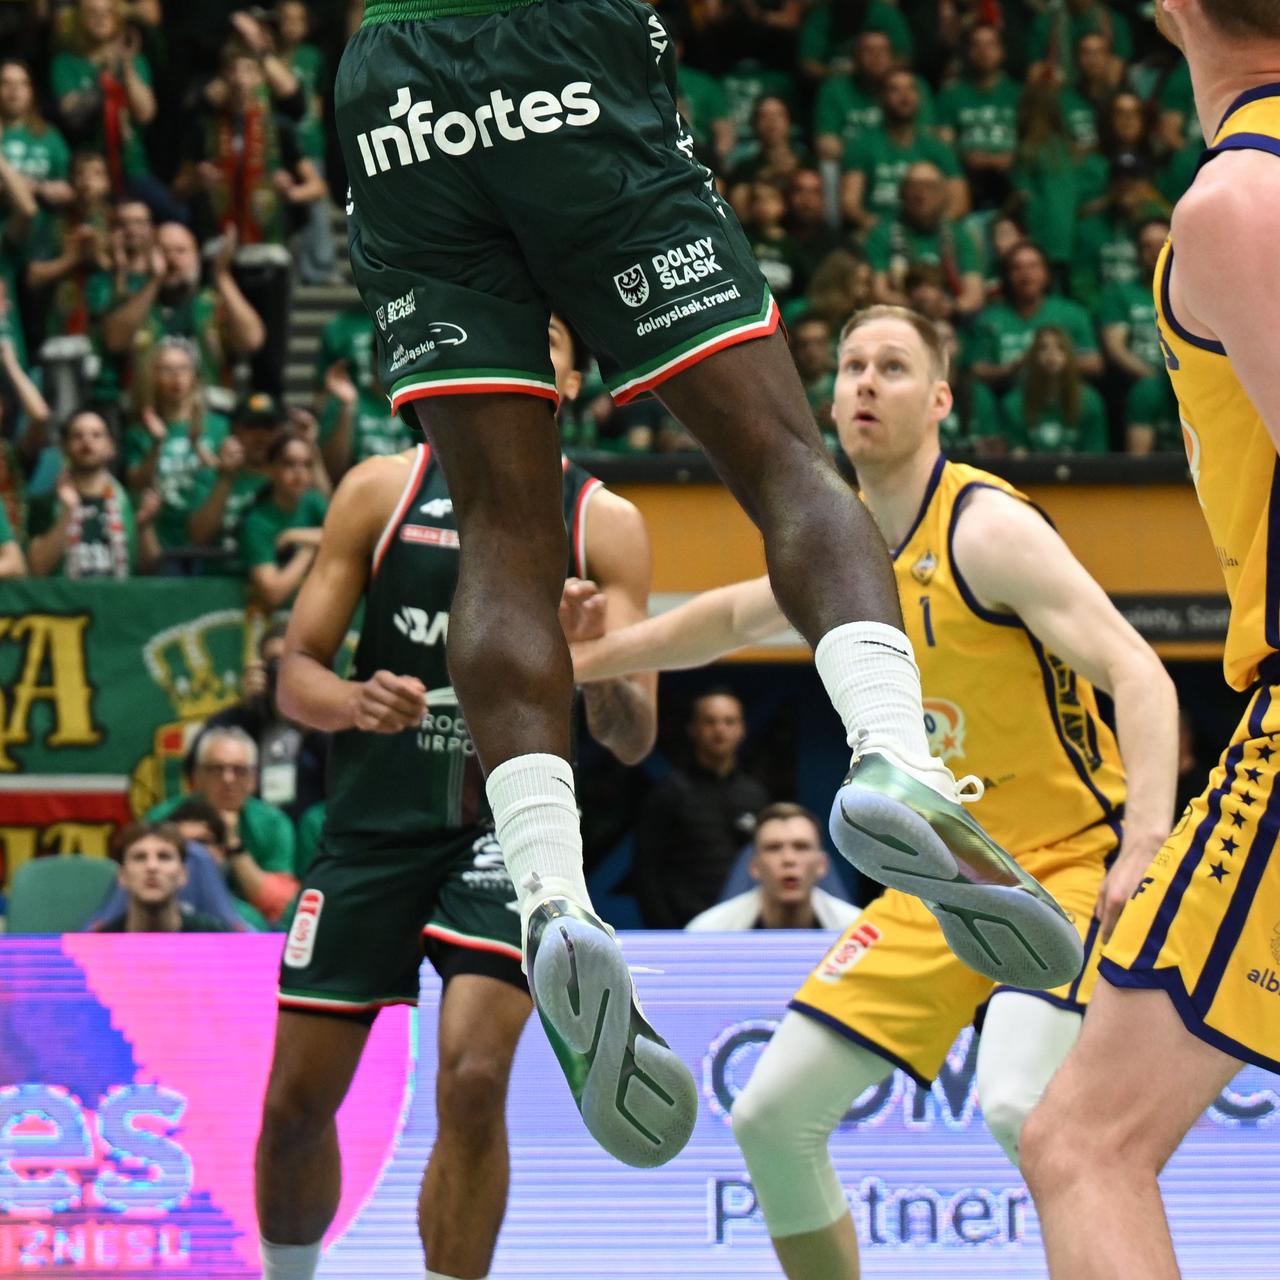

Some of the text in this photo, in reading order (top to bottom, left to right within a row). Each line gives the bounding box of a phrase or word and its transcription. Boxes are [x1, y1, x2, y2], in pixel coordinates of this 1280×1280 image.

[357, 81, 601, 177] infortes
[652, 236, 714, 273] DOLNY
[636, 284, 741, 336] dolnyslask.travel
[707, 1174, 1029, 1248] Ptner
